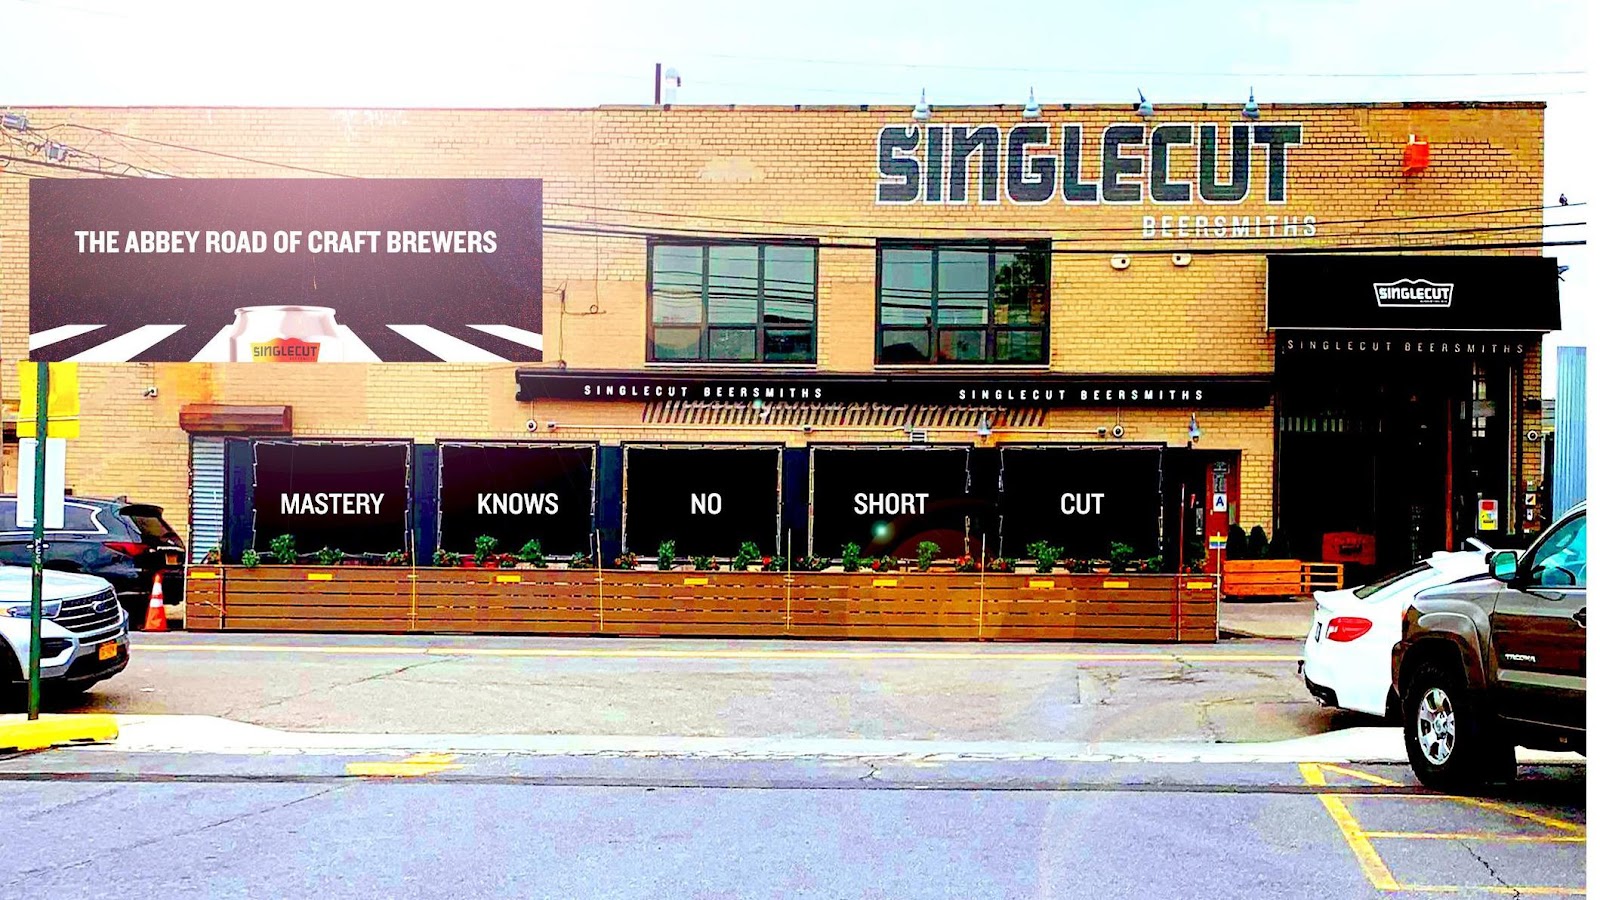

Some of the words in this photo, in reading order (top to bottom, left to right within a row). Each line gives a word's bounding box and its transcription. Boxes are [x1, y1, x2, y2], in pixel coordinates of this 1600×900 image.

[875, 123, 1304, 205] SINGLECUT
[1142, 215, 1318, 238] BEERSMITHS
[75, 230, 119, 253] THE
[124, 230, 200, 253] ABBEY
[205, 230, 267, 253] ROAD
[273, 230, 303, 253] OF
[308, 230, 381, 253] CRAFT
[387, 230, 497, 253] BREWERS
[1378, 287, 1451, 300] SINGLECUT
[253, 345, 318, 357] SINGLECUT
[1287, 339, 1392, 352] SINGLECUT
[1404, 342, 1523, 354] BEERSMITHS
[584, 384, 688, 397] SINGLECUT
[703, 386, 823, 399] BEERSMITHS
[959, 389, 1066, 400] SINGLECUT
[1080, 389, 1203, 401] BEERSMITHS
[281, 492, 385, 515] MASTERY
[477, 492, 559, 515] KNOWS
[691, 492, 722, 515] NO
[854, 492, 929, 515] SHORT
[1060, 492, 1105, 515] CUT
[1215, 495, 1225, 507] A
